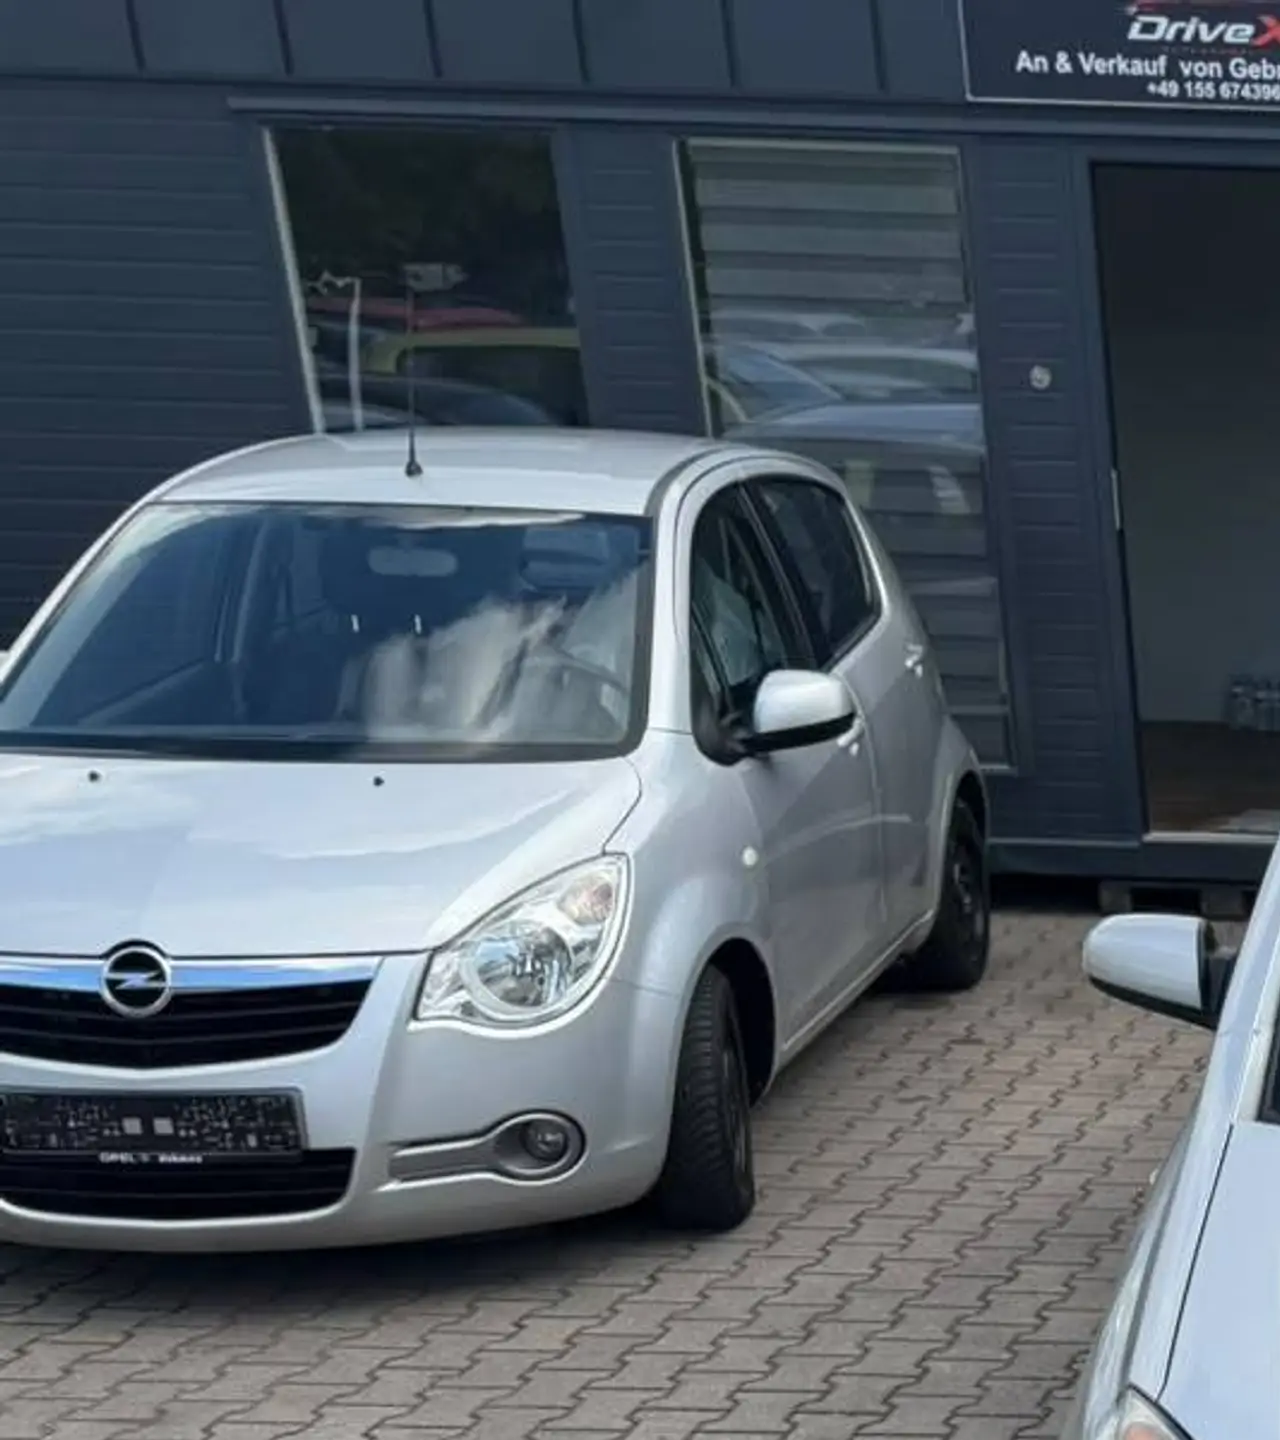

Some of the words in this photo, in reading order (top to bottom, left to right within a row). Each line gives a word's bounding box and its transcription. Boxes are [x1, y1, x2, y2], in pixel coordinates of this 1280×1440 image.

[1016, 50, 1049, 73] An
[1055, 51, 1073, 74] &
[1077, 52, 1168, 77] Verkauf
[1179, 60, 1224, 79] von
[1147, 80, 1180, 98] +49
[1184, 80, 1216, 99] 155
